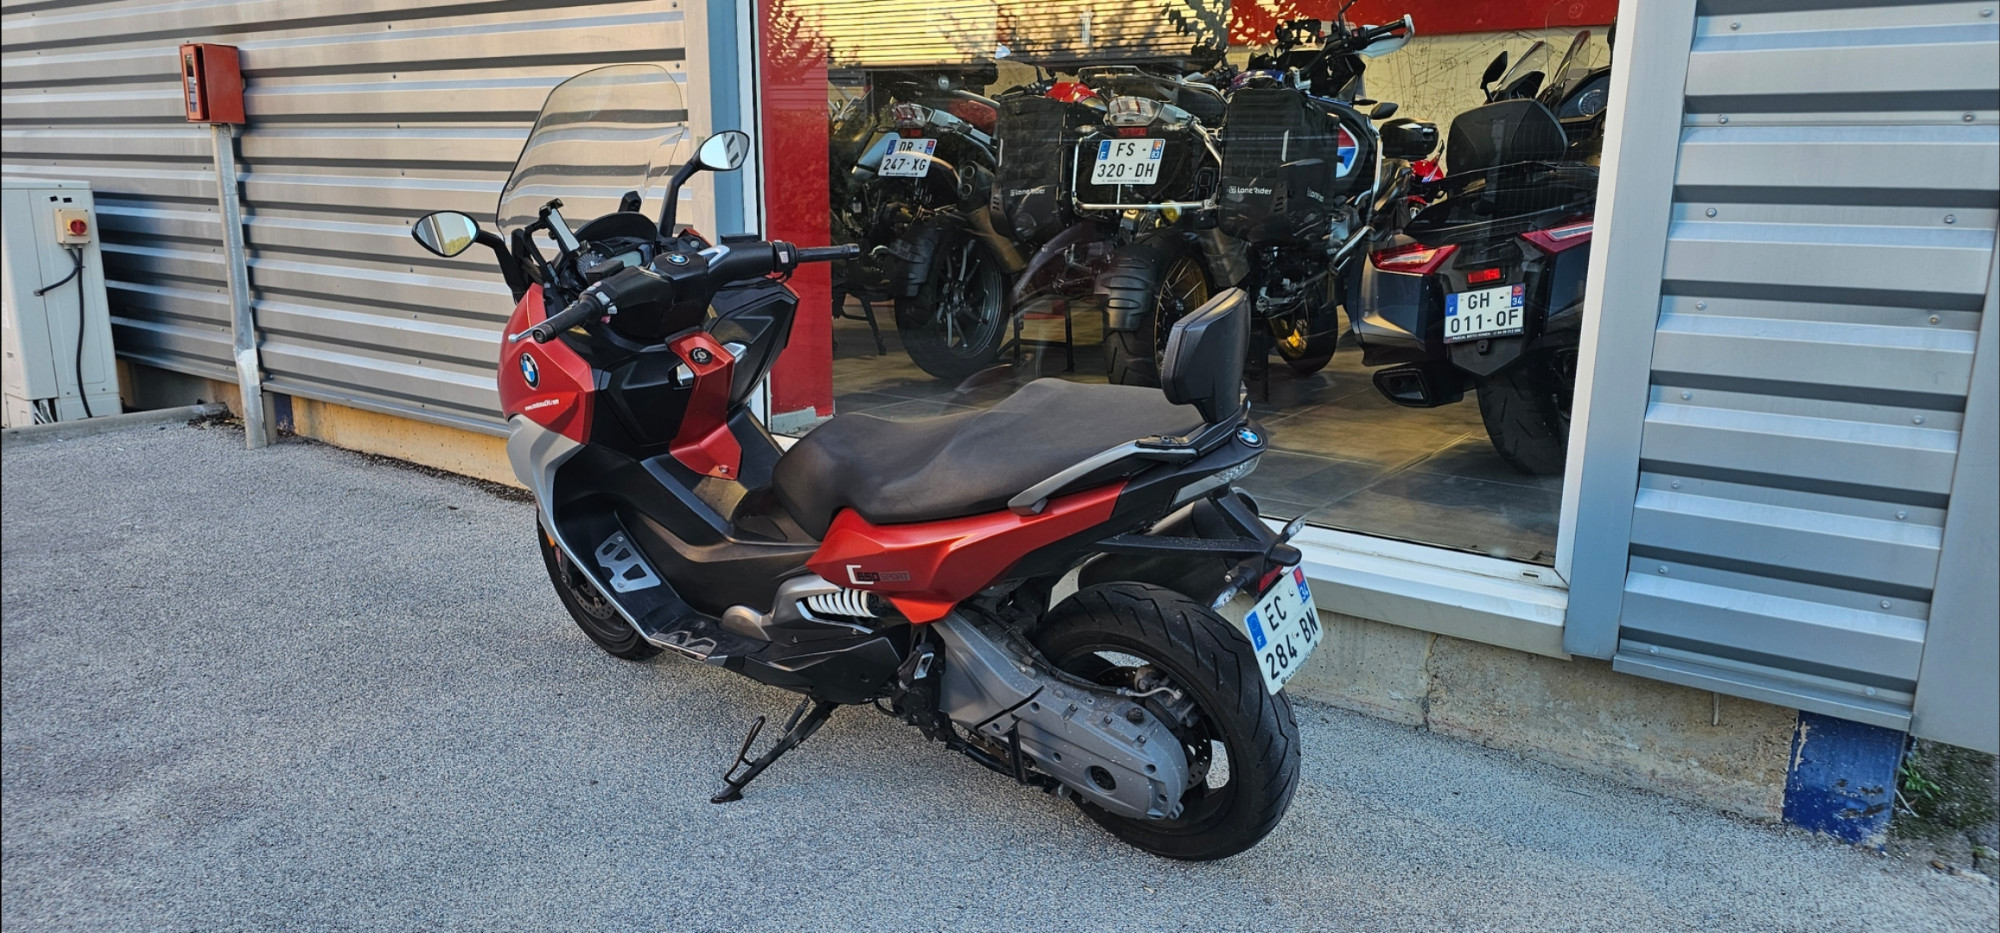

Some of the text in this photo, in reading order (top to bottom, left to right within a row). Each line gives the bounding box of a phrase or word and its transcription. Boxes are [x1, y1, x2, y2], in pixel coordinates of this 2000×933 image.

[1100, 151, 1106, 160] F
[1116, 142, 1136, 157] FS
[1097, 162, 1155, 178] 320-DH
[1468, 292, 1489, 309] GH
[1512, 296, 1523, 306] 34
[1451, 309, 1518, 333] 011-QF
[1300, 583, 1310, 600] 34
[1264, 596, 1287, 631] EC
[1266, 607, 1318, 680] 284-BN
